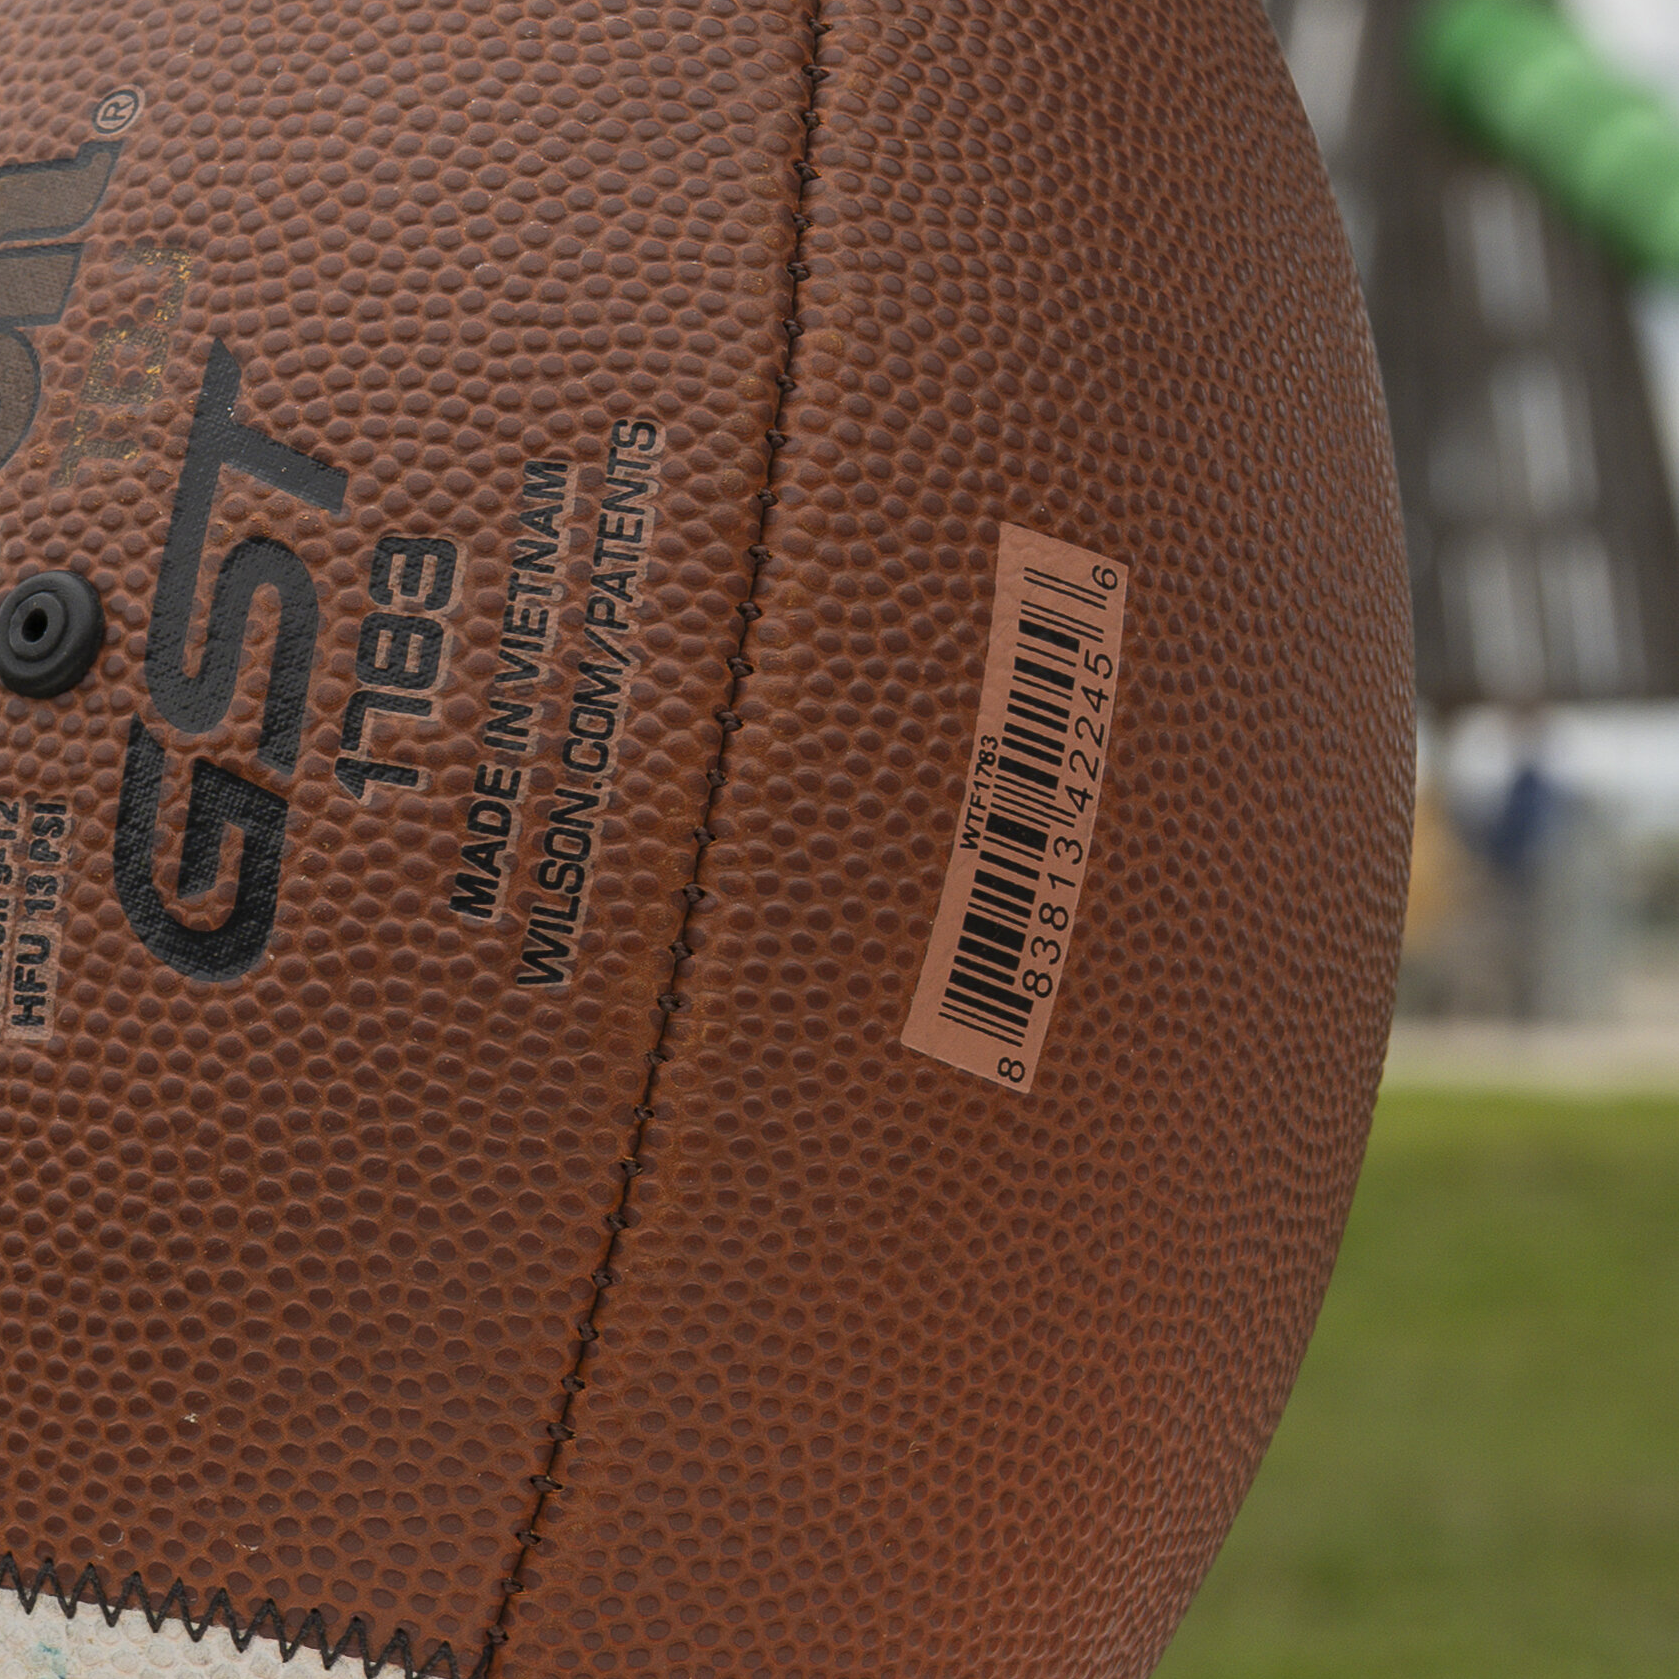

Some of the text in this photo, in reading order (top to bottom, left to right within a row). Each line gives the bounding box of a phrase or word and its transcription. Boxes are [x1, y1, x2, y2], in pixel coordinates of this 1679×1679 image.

[114, 336, 350, 983] GST
[334, 536, 459, 800] 1783
[449, 461, 571, 918] MADE IN VIETNAM
[517, 418, 658, 986] WILSON.COM/PATENTS
[960, 735, 998, 850] WTF1783
[996, 564, 1118, 1083] 8 83813 42245 6
[11, 802, 67, 1028] HFU 13 PSI
